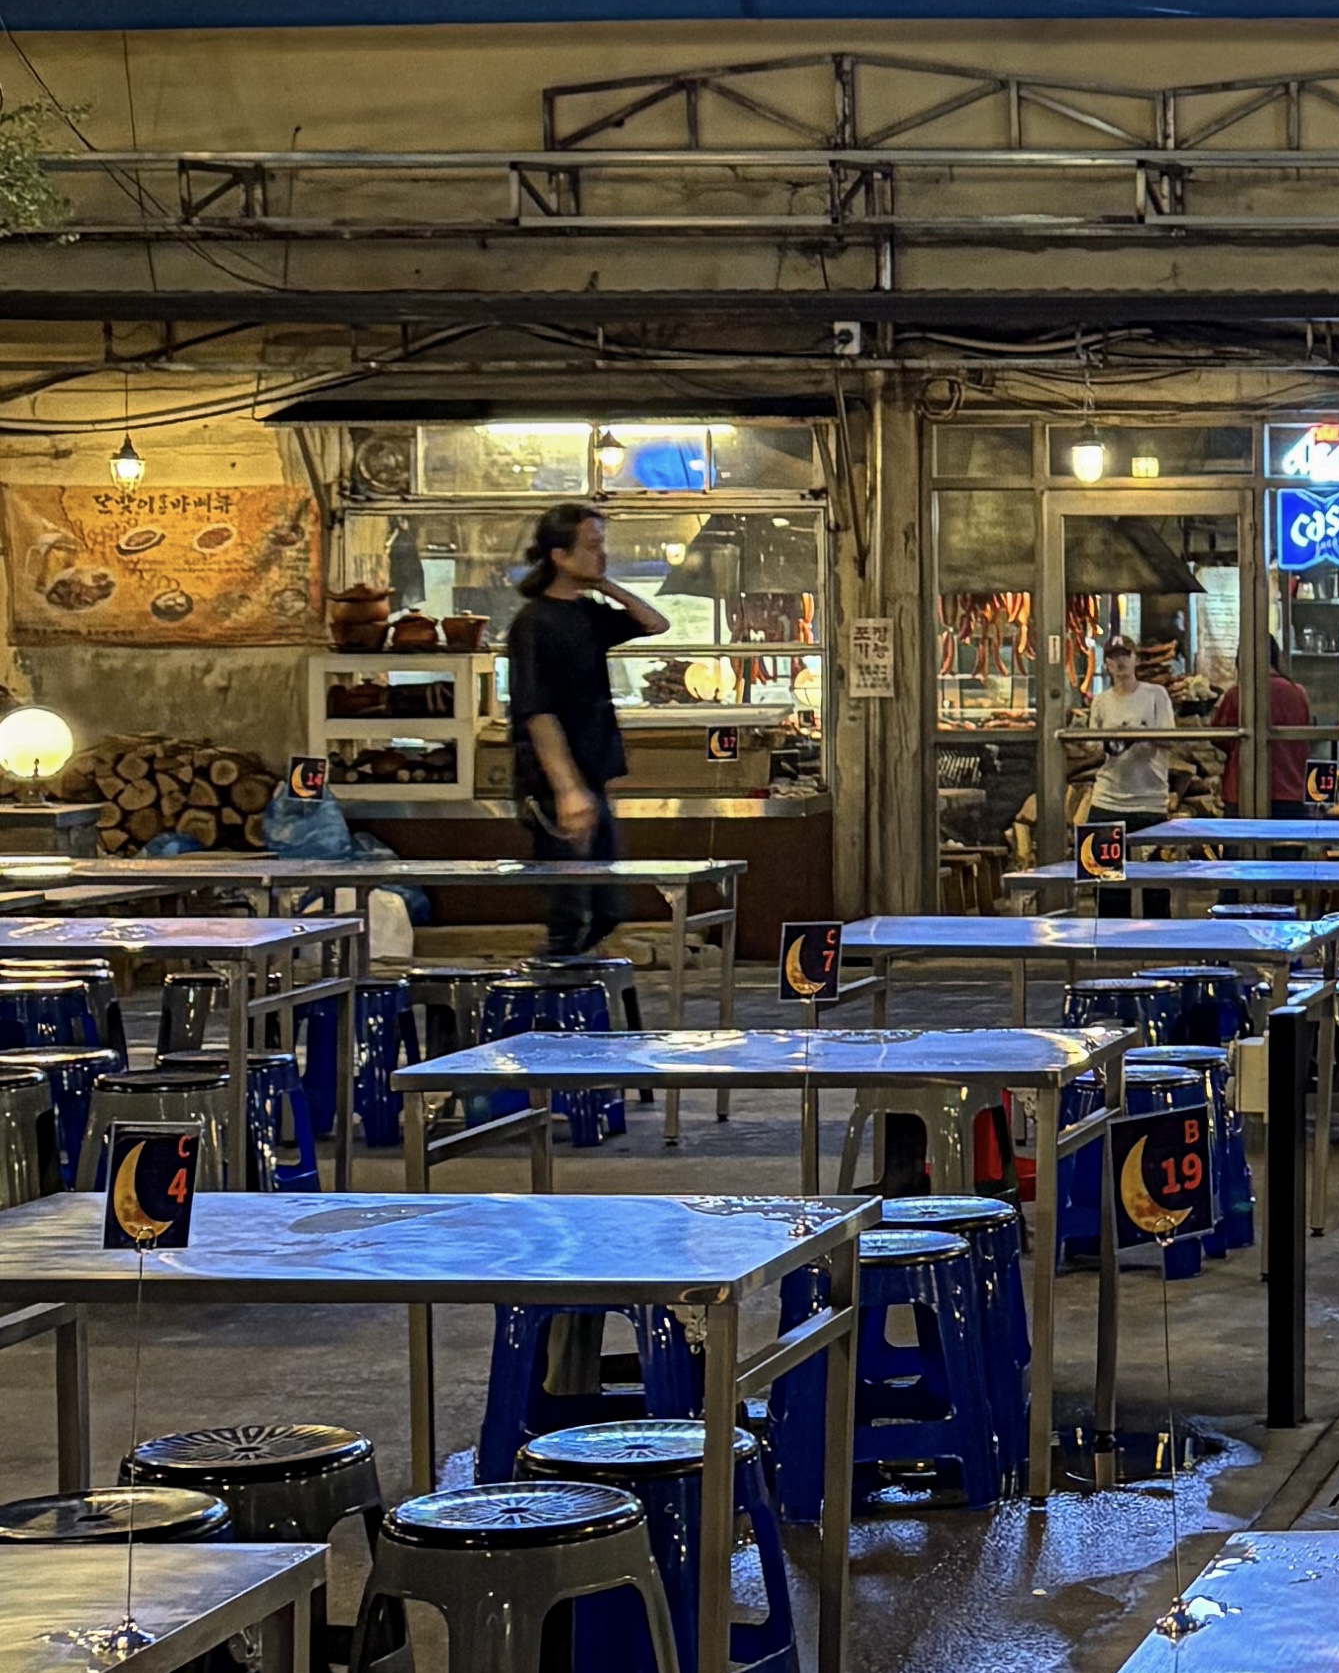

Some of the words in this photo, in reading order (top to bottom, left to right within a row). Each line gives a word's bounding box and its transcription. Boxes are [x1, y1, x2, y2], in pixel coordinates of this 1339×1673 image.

[1319, 776, 1334, 790] 13
[1112, 827, 1121, 839] C
[1100, 843, 1121, 860] 10
[827, 928, 837, 944] C
[822, 950, 835, 972] 7
[1184, 1119, 1200, 1144] B
[178, 1134, 192, 1158] C
[1161, 1152, 1203, 1195] 19
[167, 1168, 187, 1204] 4
